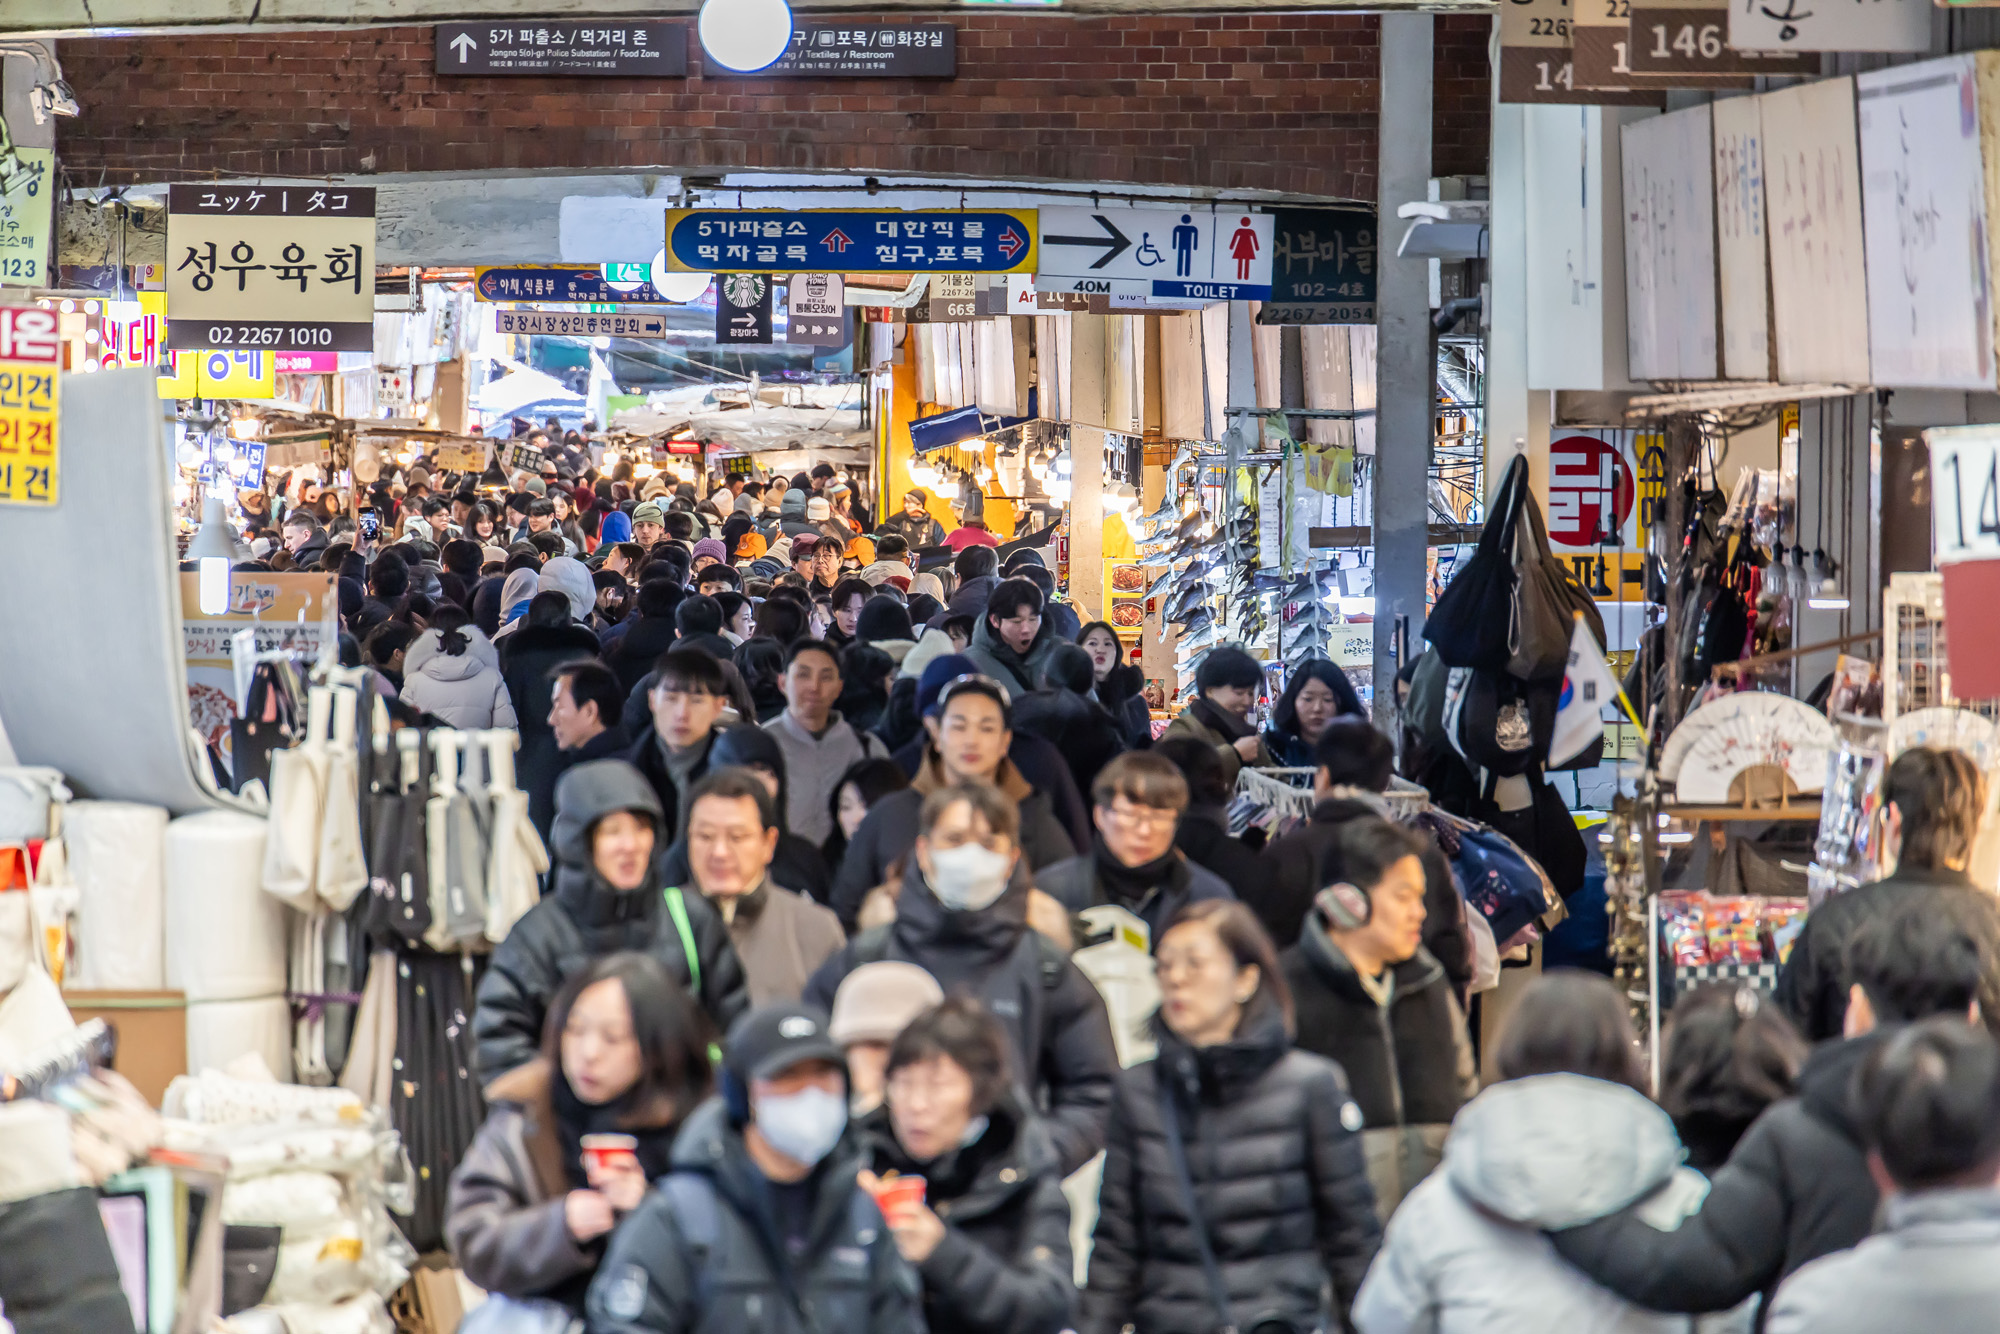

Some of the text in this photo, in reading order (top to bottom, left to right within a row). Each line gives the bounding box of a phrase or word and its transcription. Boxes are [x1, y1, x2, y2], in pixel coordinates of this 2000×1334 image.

[489, 29, 513, 45] 5가
[520, 29, 565, 46] 파출소
[581, 29, 626, 46] 먹거리
[633, 30, 648, 46] 존
[792, 31, 807, 47] 구
[836, 32, 867, 47] 포목
[897, 31, 943, 47] 화장실
[489, 48, 518, 58] Jongno
[547, 49, 569, 58] Police
[571, 49, 611, 58] Substation
[620, 49, 640, 58] Food
[641, 50, 660, 58] Zone
[806, 50, 840, 59] Textiles
[850, 51, 895, 59] Restroom
[199, 190, 266, 212] ユッケ
[306, 191, 348, 212] タコ
[698, 219, 985, 239] 5가파출소 대한직물
[698, 244, 985, 265] 먹자골목 침구,포목
[177, 240, 362, 295] 성우육회
[1074, 280, 1111, 293] 40M
[1183, 284, 1238, 299] TOILET
[1291, 282, 1365, 297] 102-4호
[1270, 307, 1373, 320] 2267-2054
[503, 314, 640, 335] 광장시장상인총연합회
[208, 327, 332, 345] 02 2267 1010
